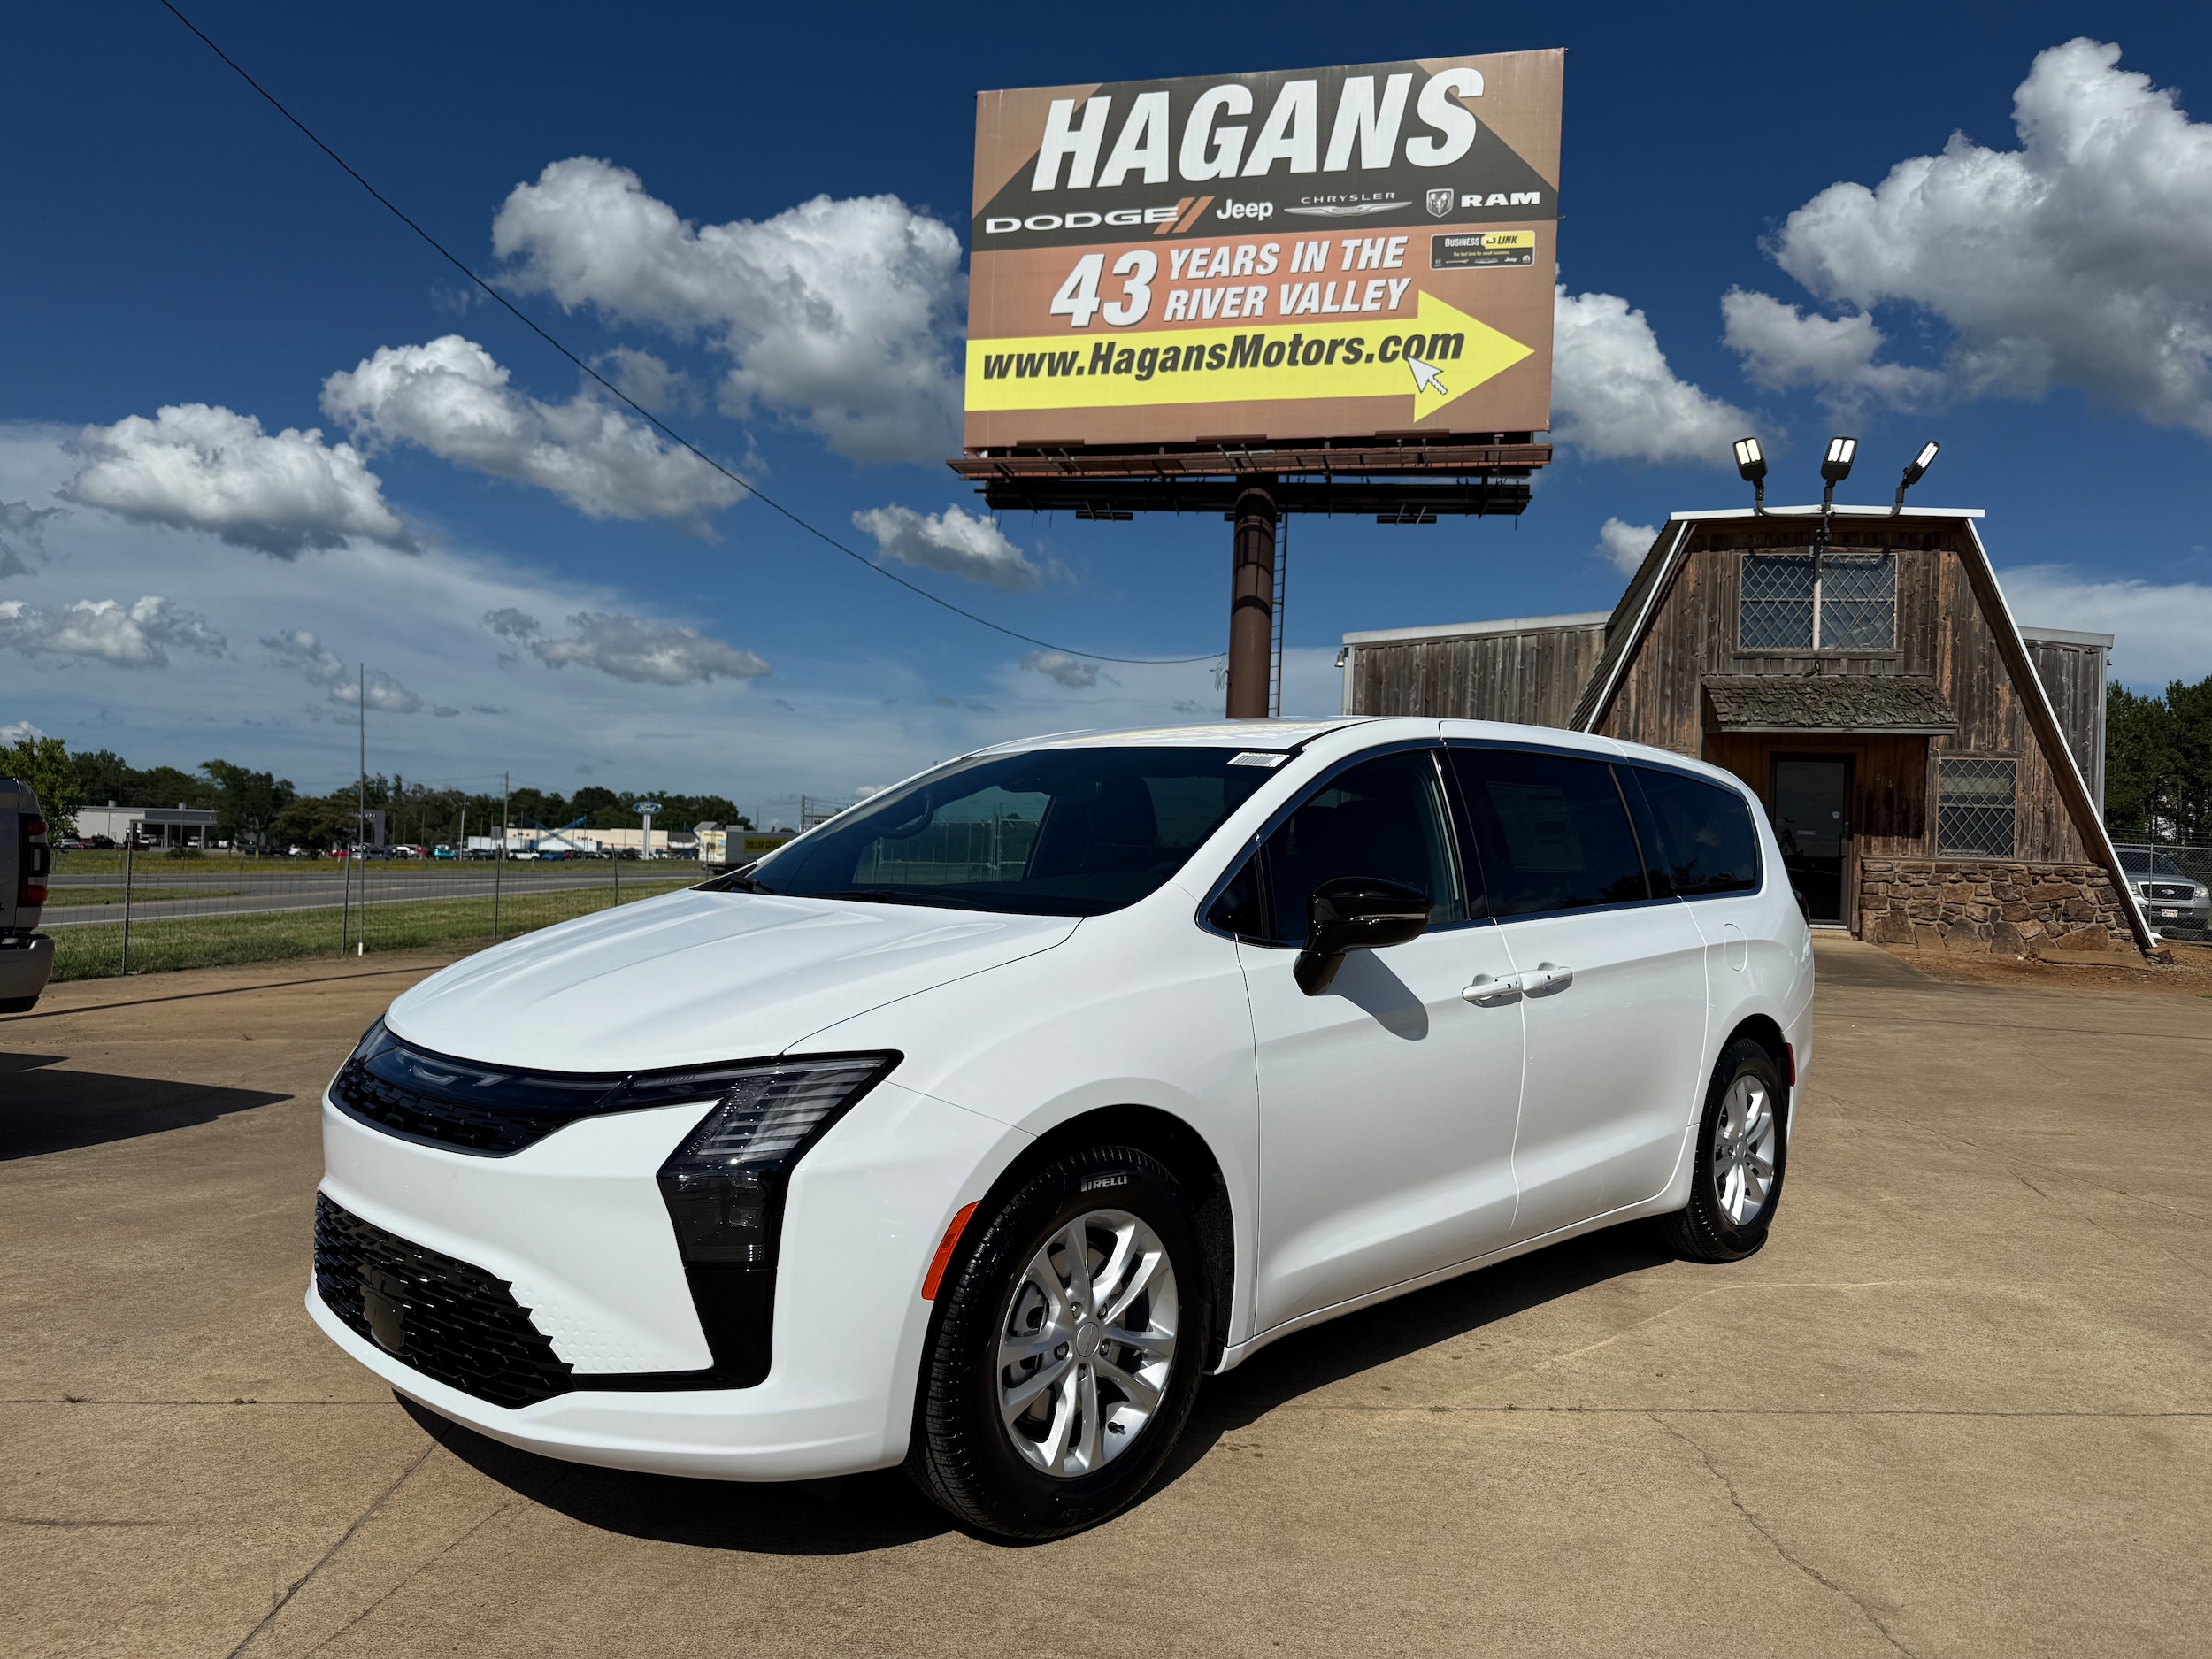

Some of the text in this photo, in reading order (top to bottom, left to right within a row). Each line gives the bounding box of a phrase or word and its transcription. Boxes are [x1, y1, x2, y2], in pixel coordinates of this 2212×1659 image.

[1030, 67, 1485, 192] HAGANS
[1216, 198, 1274, 221] Jeep
[1301, 192, 1395, 204] CHRYSLER
[1461, 191, 1540, 208] RAM
[986, 205, 1179, 234] DODGE
[1444, 234, 1518, 248] BUSINESS LINK
[1169, 236, 1409, 280] YEARS IN THE
[1049, 250, 1158, 326] 43
[1163, 278, 1412, 321] RIVER VALLEY
[983, 332, 1465, 381] www.HagansMotors.com
[746, 840, 764, 849] DOLLAR
[1080, 1171, 1127, 1193] PIRELLI
